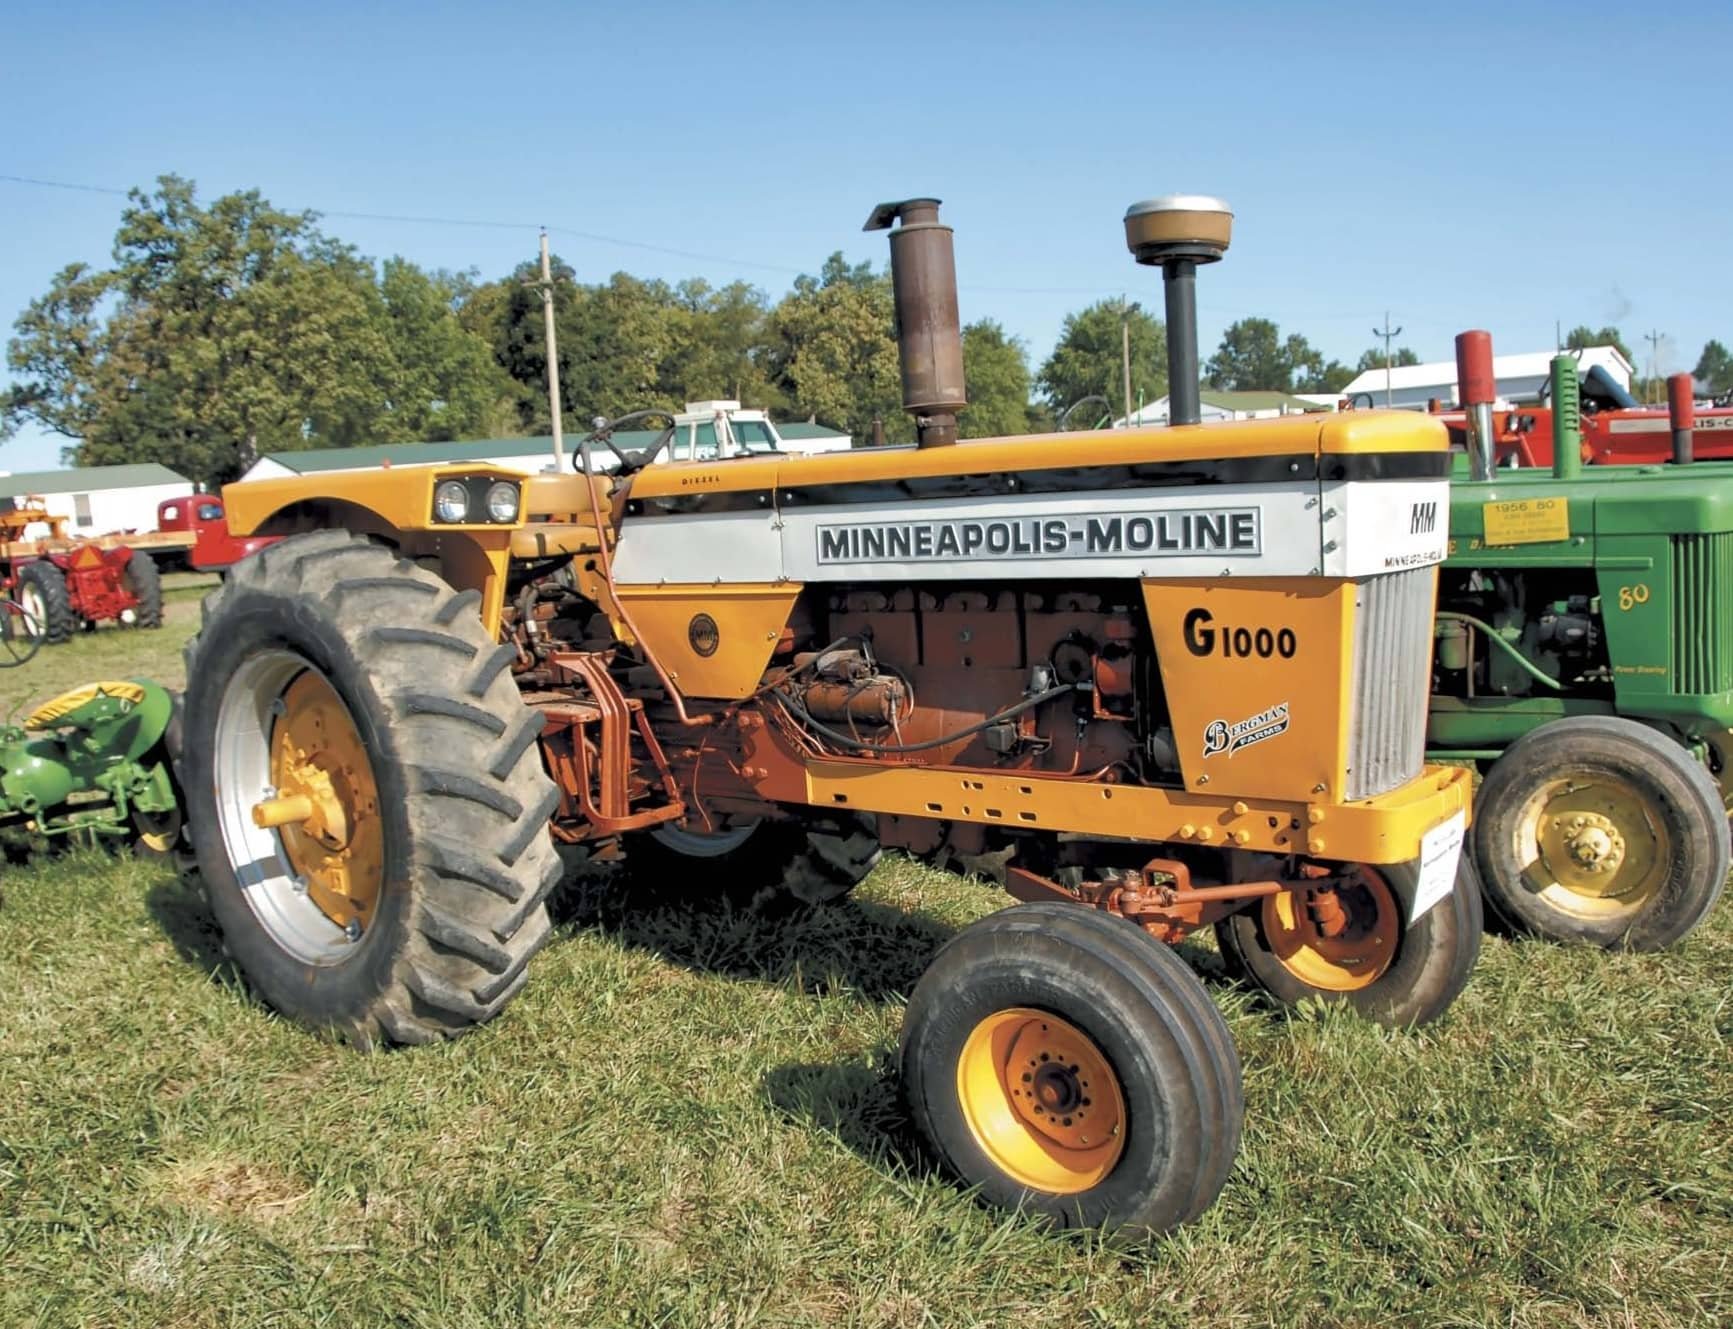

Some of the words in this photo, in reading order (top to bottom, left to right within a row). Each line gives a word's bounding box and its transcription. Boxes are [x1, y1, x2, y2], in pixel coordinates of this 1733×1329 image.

[681, 474, 720, 486] DIESEL
[1410, 502, 1437, 535] MM
[1495, 502, 1529, 513] 1956
[821, 513, 1256, 560] MINNEAPOLIS-MOLINE
[1619, 583, 1649, 611] 80
[1239, 723, 1283, 746] FARMS
